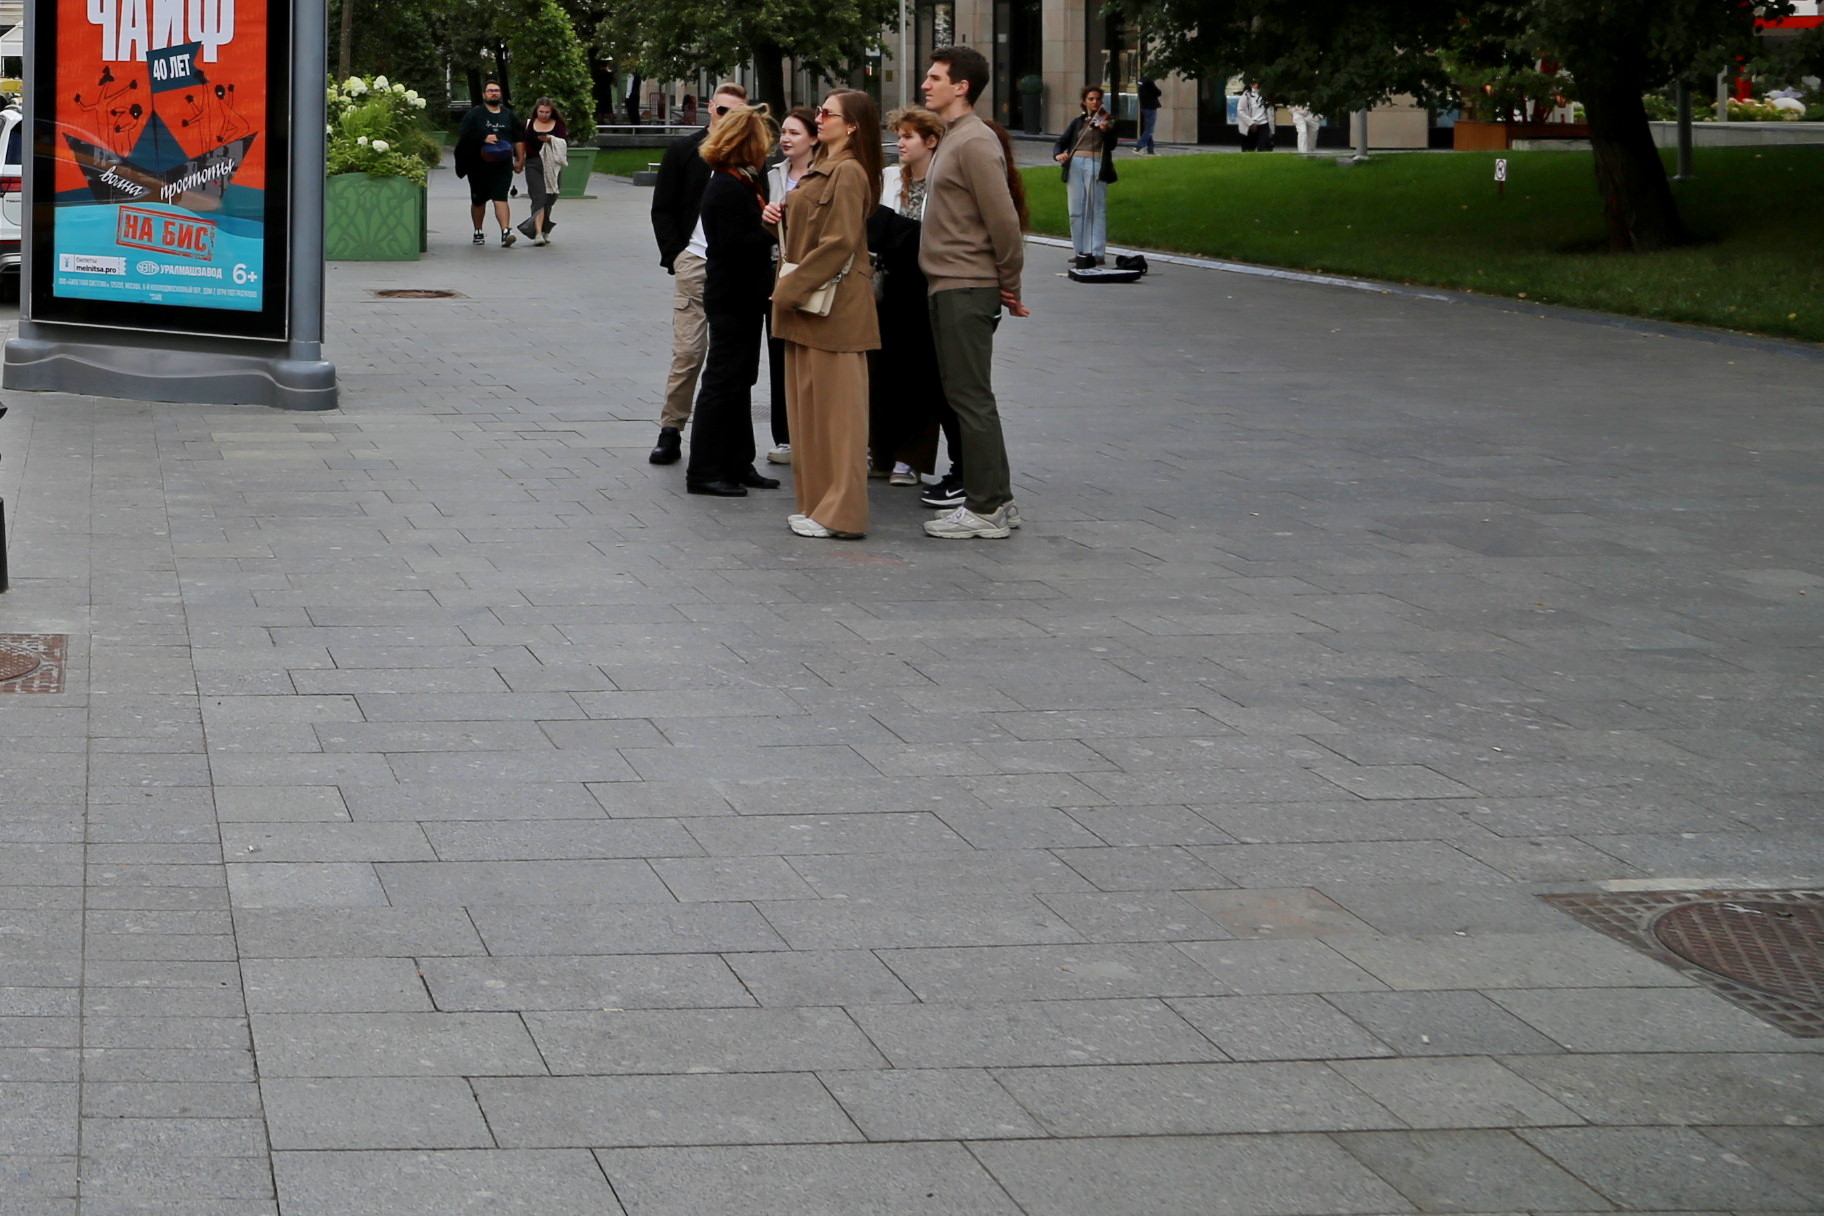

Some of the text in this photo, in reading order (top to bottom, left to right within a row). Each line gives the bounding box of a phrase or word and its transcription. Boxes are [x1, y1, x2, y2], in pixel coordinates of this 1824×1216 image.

[153, 53, 191, 81] 40 ЛЕТ
[99, 165, 143, 197] волна
[160, 158, 235, 205] простоты
[123, 214, 209, 252] НА БИС
[76, 265, 117, 274] melnitsa.pro
[160, 264, 223, 280] УРАЛМАШЗАВОД
[232, 263, 257, 285] 6+
